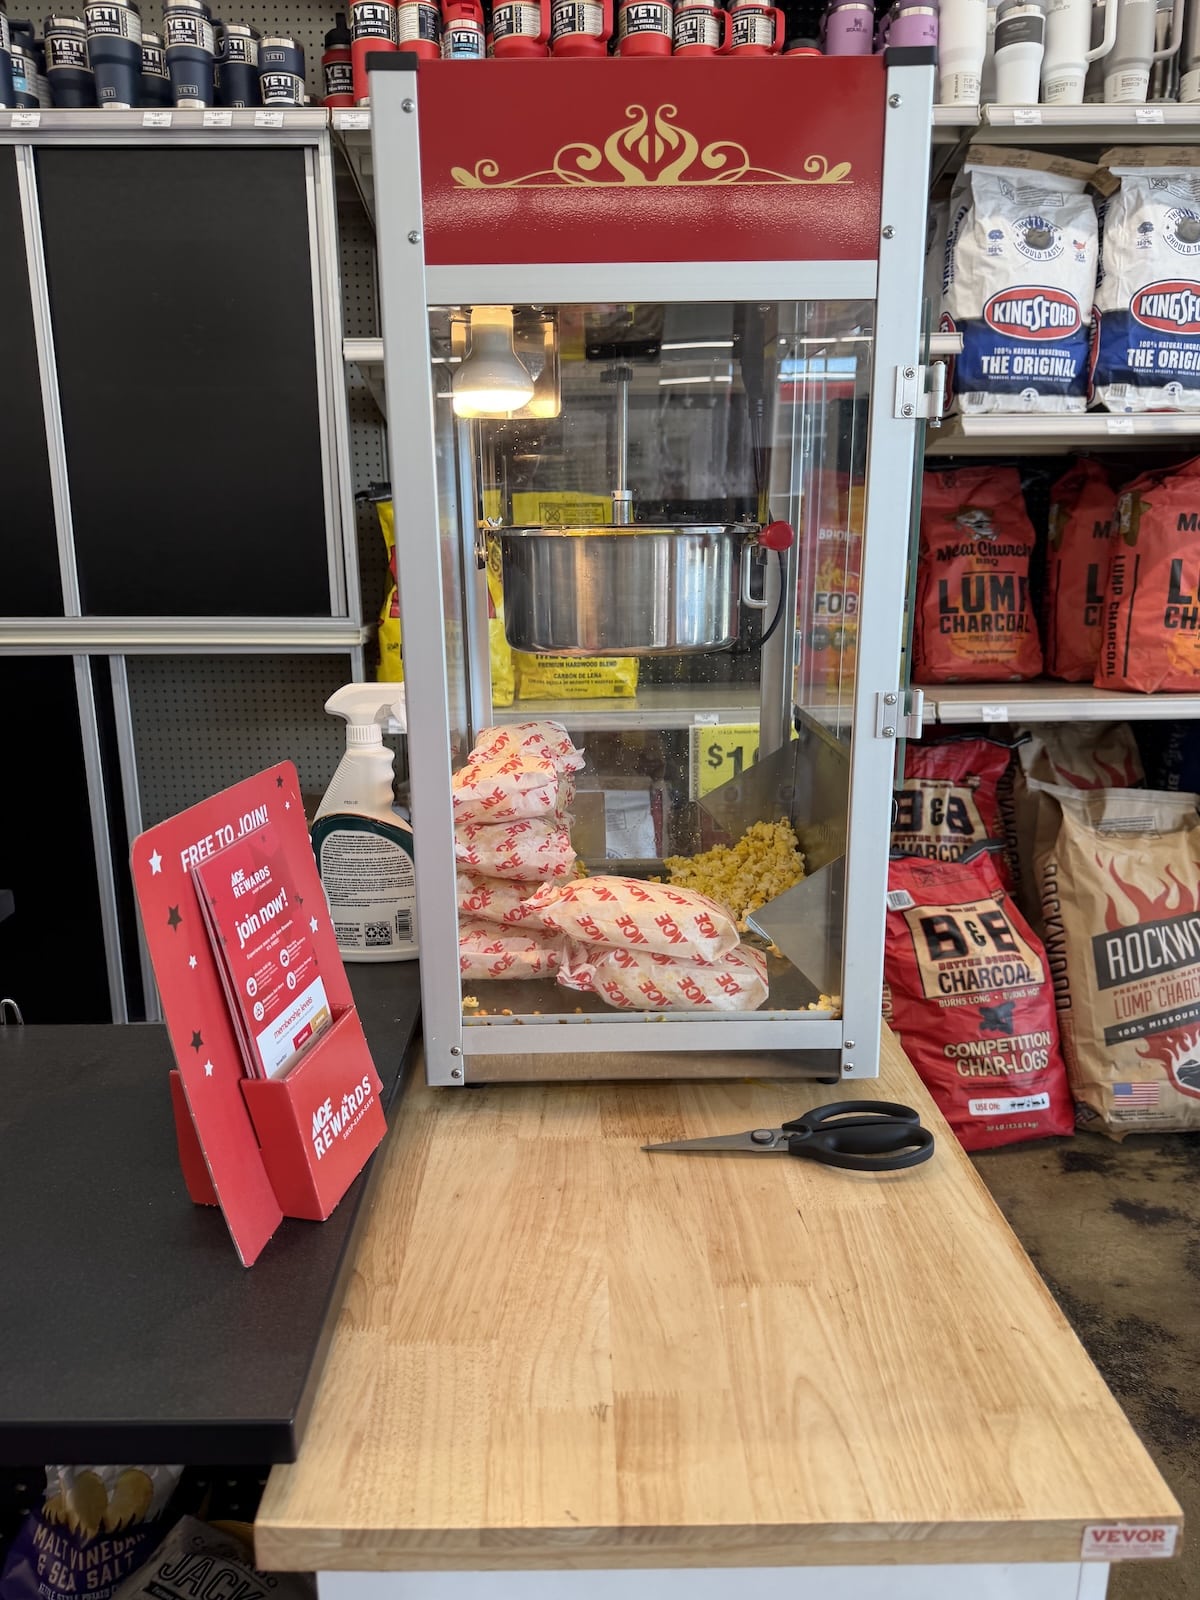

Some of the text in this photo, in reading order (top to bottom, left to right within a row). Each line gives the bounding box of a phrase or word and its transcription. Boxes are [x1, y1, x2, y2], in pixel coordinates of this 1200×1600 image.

[86, 7, 117, 21] YETI
[355, 5, 389, 20] YETI
[629, 6, 660, 19] YETI
[167, 19, 195, 30] YETI
[674, 19, 696, 33] YETI
[53, 40, 84, 52] YETI
[453, 32, 478, 44] YETI
[264, 76, 291, 87] YETI
[326, 65, 352, 79] YET
[1017, 240, 1042, 259] SHOULD
[1044, 244, 1061, 258] TASTE
[1167, 234, 1192, 253] SHOULD
[993, 296, 1077, 332] KINGSFORD
[994, 347, 1011, 355] 100%
[1127, 349, 1154, 367] THE
[981, 355, 1076, 378] THE ORIGINAL
[936, 541, 1032, 561] Meat Church
[940, 613, 1031, 634] CHARCOAL
[1107, 555, 1126, 679] LUMP CHARCOAL
[566, 660, 598, 668] HARDWOOD
[480, 786, 507, 810] ACE
[180, 803, 269, 873] FREE TO JOIN!
[504, 821, 532, 837] ACE
[496, 838, 518, 852] CE
[495, 852, 523, 872] ACE
[231, 868, 245, 887] ACE
[232, 865, 271, 899] REWARDS
[462, 889, 494, 911] ACE
[502, 904, 534, 922] ACE
[235, 913, 261, 950] join
[577, 914, 610, 942] ACE
[615, 914, 650, 944] ACE
[654, 913, 688, 944] ACE
[693, 912, 720, 939] ACE
[483, 940, 504, 954] CE
[919, 915, 970, 961] B
[488, 952, 516, 977] ACE
[614, 948, 640, 969] AC
[715, 972, 743, 997] ACE
[938, 963, 1036, 994] CHARCOAL
[1113, 980, 1156, 996] PREMIUM
[602, 980, 635, 1007] ACE
[638, 978, 672, 1006] ACE
[676, 976, 712, 1005] ACE
[938, 997, 967, 1008] BURNS
[968, 995, 991, 1005] LONG
[1003, 988, 1026, 1000] BURNS
[1115, 974, 1200, 1020] LUMP CHARC
[1118, 1011, 1199, 1037] 100% MISSOURI
[943, 1031, 1051, 1058] COMPETITION
[956, 1049, 1049, 1077] CHAR-LOGS
[314, 1075, 371, 1160] REWARDS
[975, 1103, 988, 1111] USE
[312, 1097, 333, 1140] ACE
[33, 1525, 68, 1560] MALT
[1091, 1529, 1165, 1543] VEVOR
[48, 1561, 77, 1592] SEA
[86, 1551, 135, 1590] SALT
